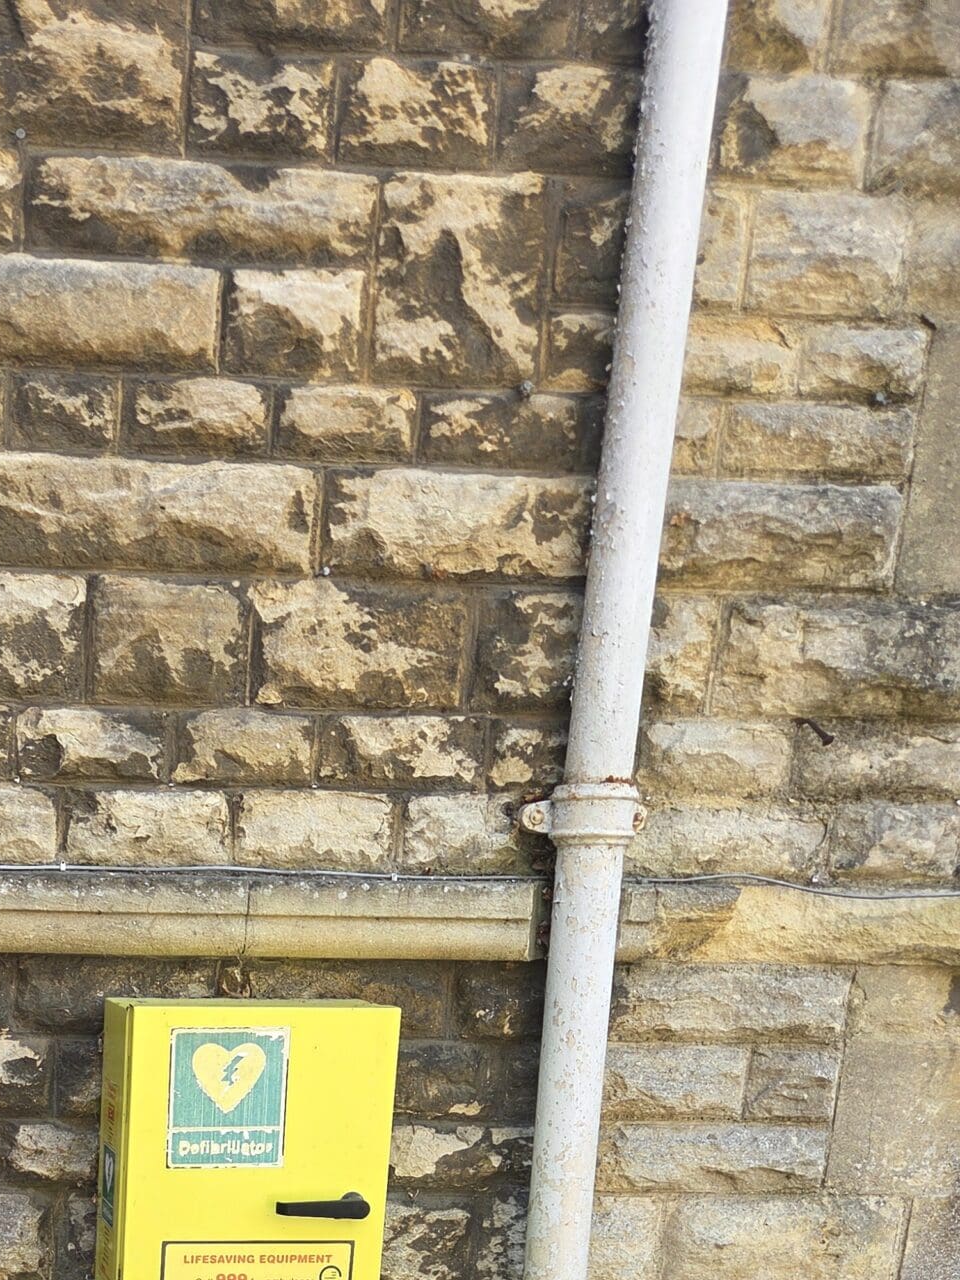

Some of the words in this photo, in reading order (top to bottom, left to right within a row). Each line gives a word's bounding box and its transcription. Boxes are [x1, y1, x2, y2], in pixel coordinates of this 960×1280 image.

[178, 1139, 273, 1157] Defibrillator
[183, 1254, 255, 1264] LIFESAVING
[259, 1254, 333, 1264] EQUIPMENT
